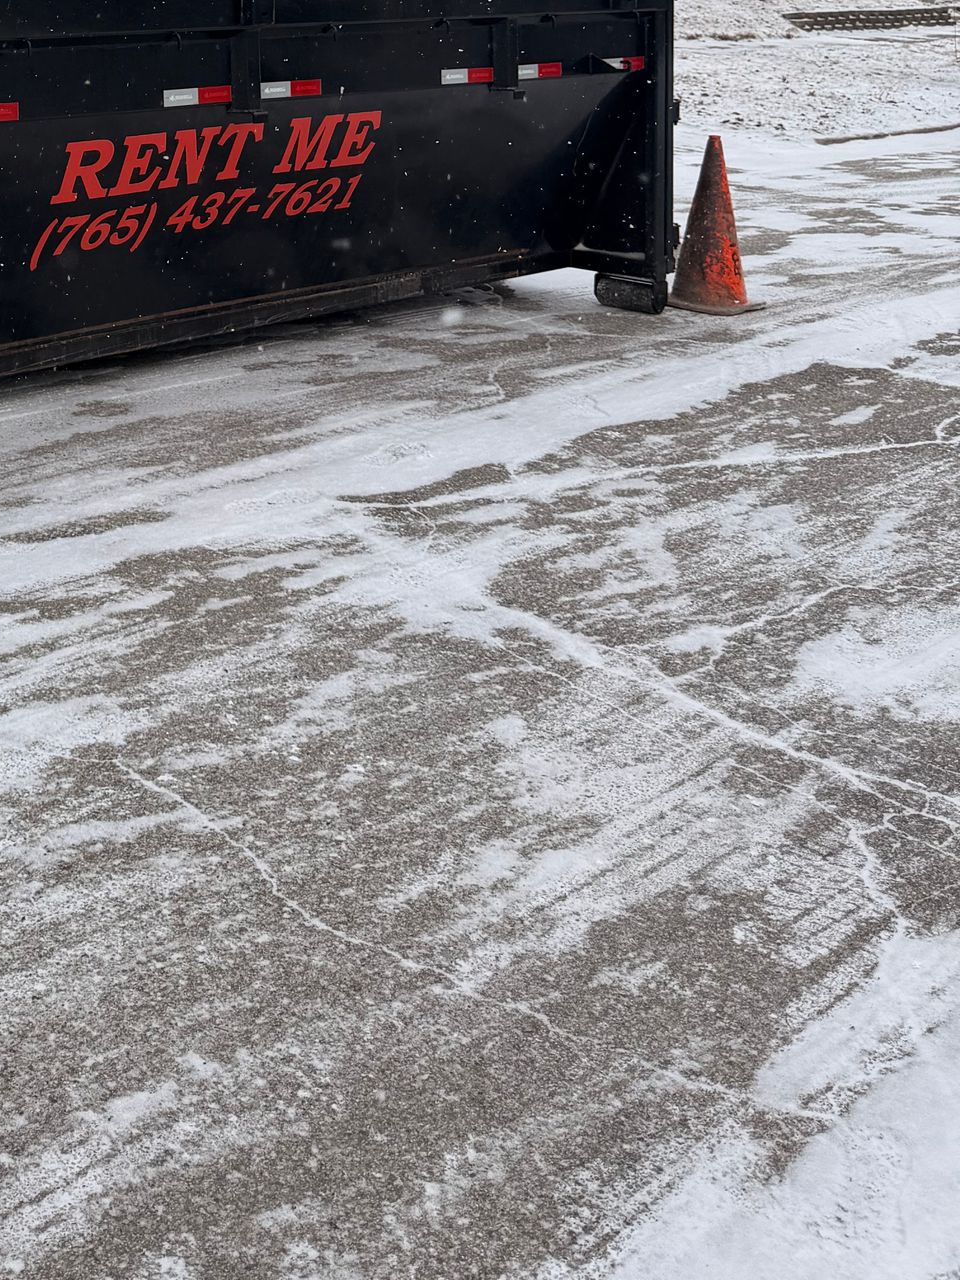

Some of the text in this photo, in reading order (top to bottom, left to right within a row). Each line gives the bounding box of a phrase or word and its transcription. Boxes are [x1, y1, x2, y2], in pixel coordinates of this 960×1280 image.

[50, 110, 382, 205] RENT ME
[29, 174, 362, 271] (765) 437-7621
